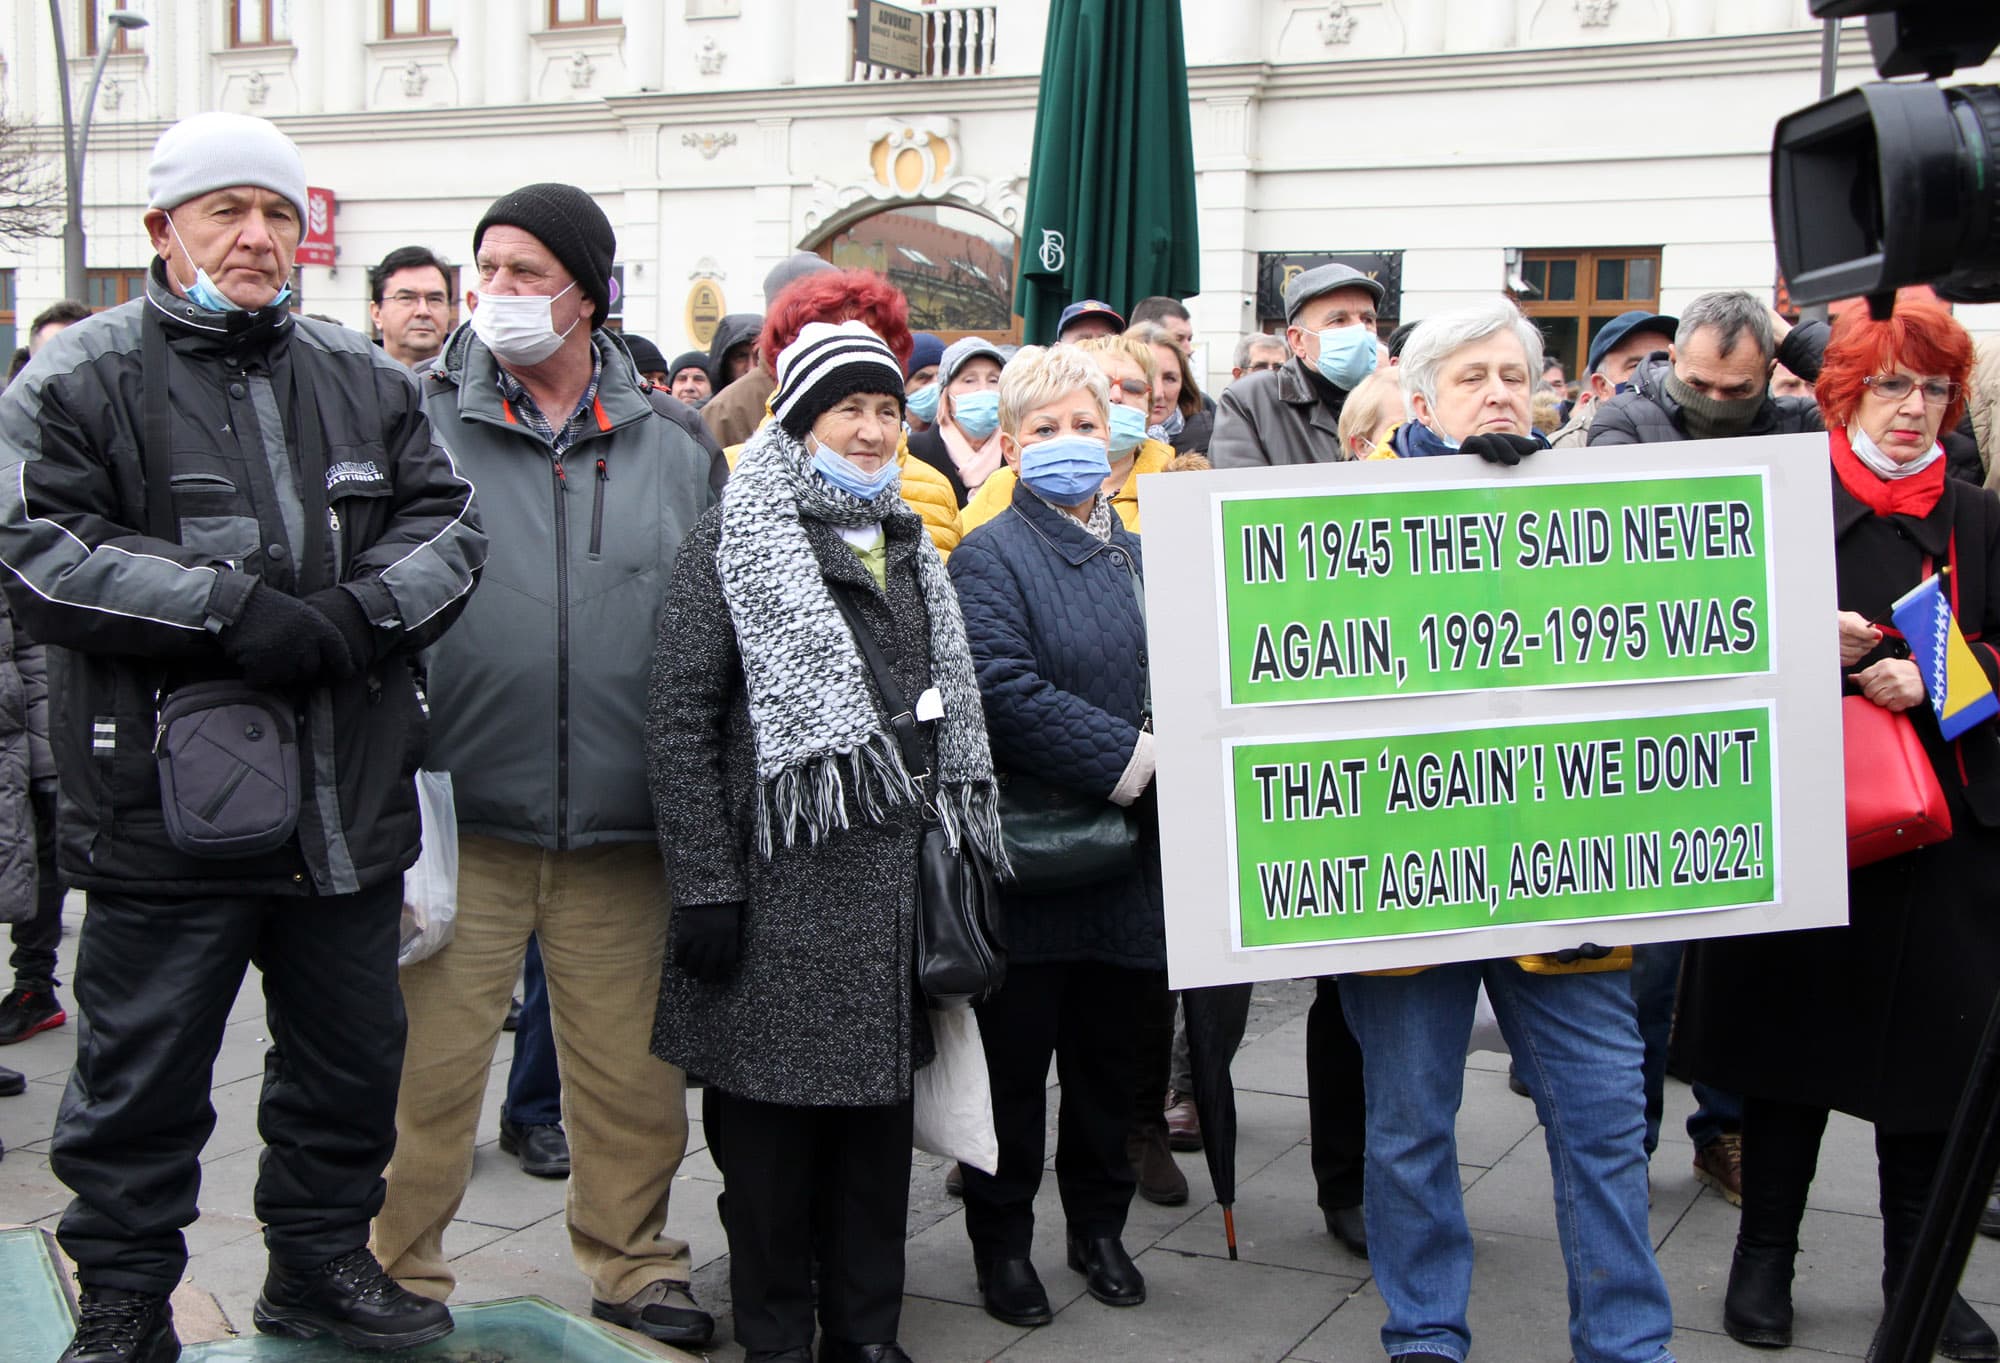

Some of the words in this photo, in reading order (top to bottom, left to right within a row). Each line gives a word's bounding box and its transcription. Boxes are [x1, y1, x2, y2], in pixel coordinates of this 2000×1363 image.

[1243, 525, 1285, 582] IN
[1299, 520, 1391, 579] 1945
[1402, 514, 1505, 573] THEY
[1518, 509, 1610, 568] SAID
[1624, 502, 1753, 562] NEVER
[1251, 619, 1406, 682] AGAIN,
[1421, 604, 1647, 670] 1992-1995
[1659, 598, 1756, 656] WAS
[1254, 760, 1366, 821] THAT
[1556, 740, 1623, 798] WE
[1637, 729, 1756, 792] DON'T
[1259, 857, 1367, 918] WANT
[1378, 847, 1498, 910] AGAIN,
[1508, 837, 1614, 898] AGAIN
[1626, 833, 1660, 888] IN
[1671, 824, 1761, 884] 2022!
